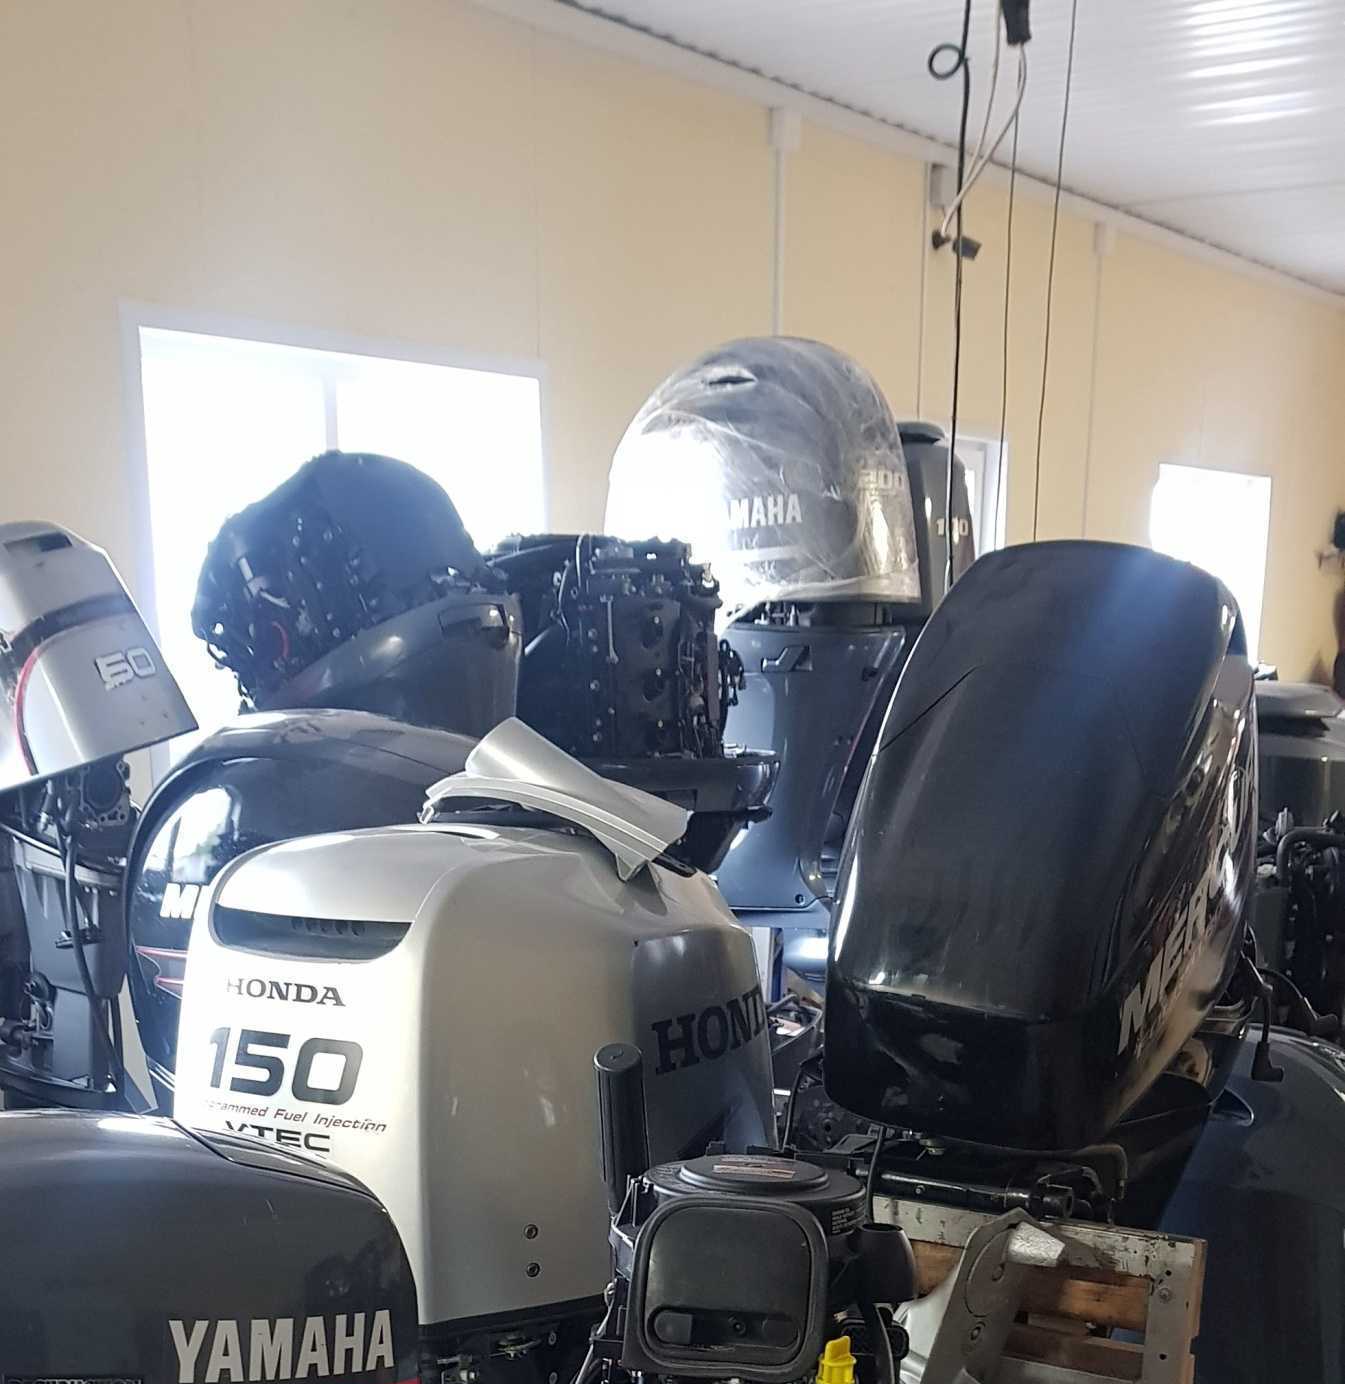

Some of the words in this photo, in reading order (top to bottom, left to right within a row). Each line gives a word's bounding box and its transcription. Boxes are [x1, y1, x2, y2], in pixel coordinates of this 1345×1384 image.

[729, 493, 802, 530] MAHA
[227, 978, 346, 1007] HONDA
[210, 1027, 363, 1106] 150
[225, 1120, 331, 1153] VTEC
[273, 1108, 308, 1124] Fuel
[312, 1113, 387, 1134] Injection
[168, 1309, 395, 1384] YAMAHA
